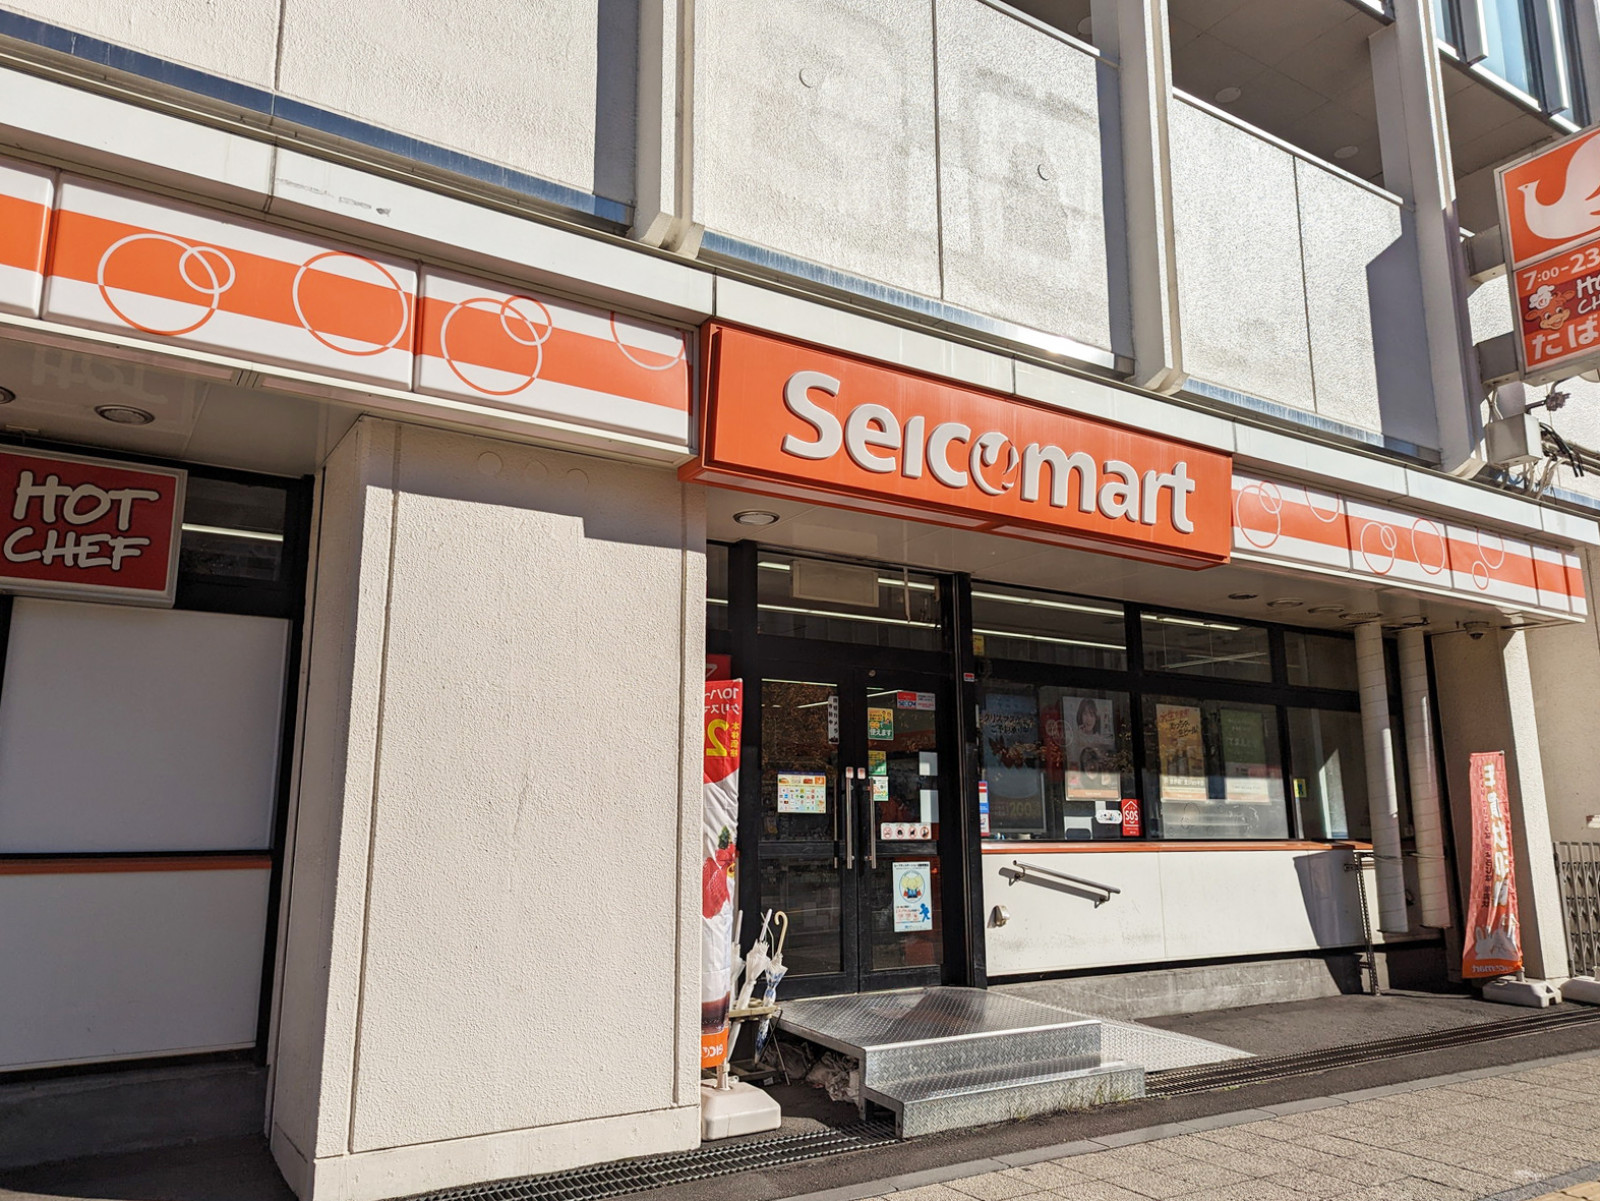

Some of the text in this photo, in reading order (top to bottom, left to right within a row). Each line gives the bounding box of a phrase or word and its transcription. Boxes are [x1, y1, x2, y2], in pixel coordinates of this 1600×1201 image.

[781, 370, 1196, 535] Seicomart
[13, 471, 160, 531] HOT
[3, 526, 150, 571] CHEF
[1125, 810, 1139, 821] SOS
